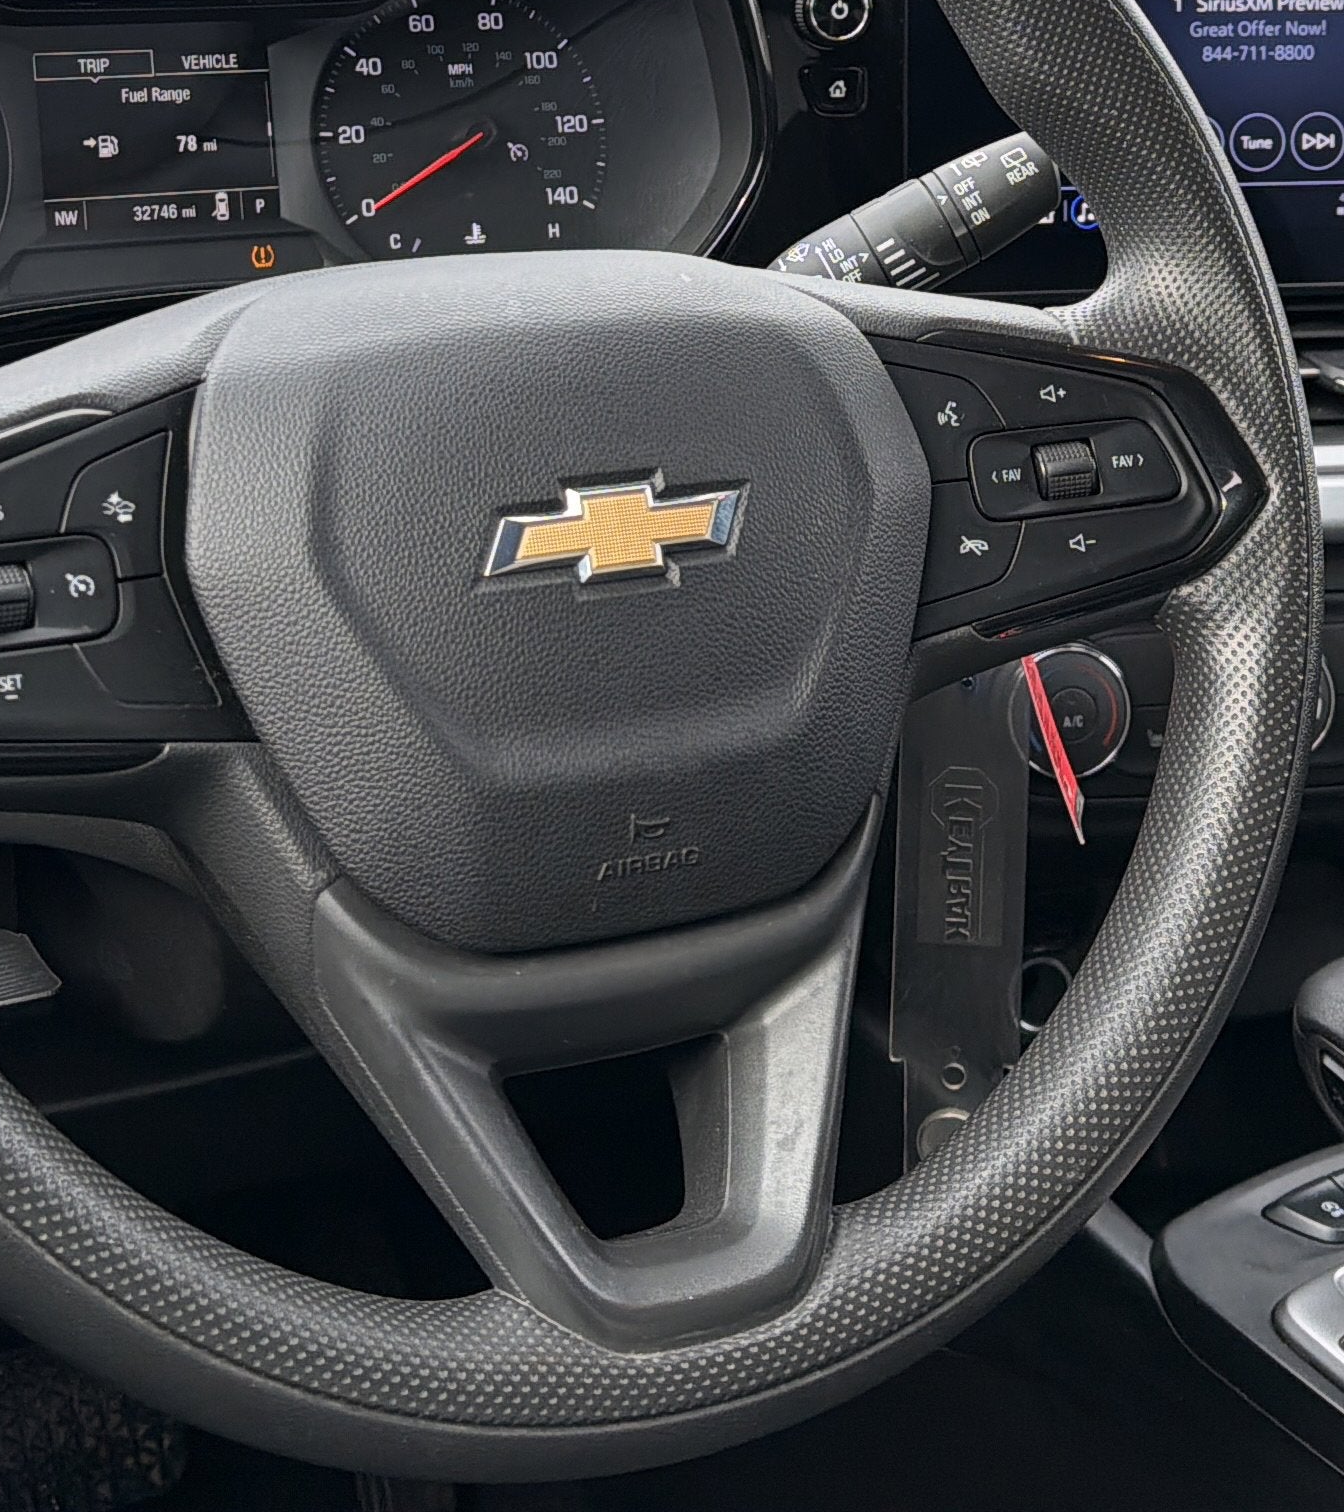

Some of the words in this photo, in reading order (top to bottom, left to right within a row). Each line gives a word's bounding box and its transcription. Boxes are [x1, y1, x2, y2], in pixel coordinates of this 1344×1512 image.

[408, 14, 435, 32] 60
[477, 13, 503, 30] 80
[1190, 22, 1234, 39] Great
[1238, 21, 1282, 38] Offer
[1285, 20, 1327, 37] Now!
[427, 44, 445, 55] 100
[462, 42, 479, 53] 120
[1202, 45, 1315, 62] 844-711-8800
[77, 58, 110, 74] TRIP
[181, 54, 239, 70] VEHICLE
[355, 58, 382, 76] 40
[524, 51, 558, 69] 100
[448, 63, 473, 76] MPH
[121, 87, 148, 103] Fuel
[152, 87, 191, 104] Range
[555, 115, 588, 133] 120
[338, 125, 365, 144] 20
[176, 135, 197, 152] 78
[203, 139, 217, 151] mi
[1240, 136, 1273, 151] Tune
[372, 153, 387, 163] 20
[1006, 161, 1040, 186] REAR
[953, 176, 976, 197] OFF
[545, 187, 578, 205] 140
[961, 191, 983, 212] INT
[132, 205, 178, 221] 32746
[181, 205, 197, 218] mi
[256, 199, 265, 213] P
[361, 199, 376, 217] 0
[55, 210, 78, 226] NW
[970, 206, 991, 226] ON
[548, 223, 560, 238] H
[390, 234, 402, 250] C
[821, 237, 837, 253] HI
[829, 248, 845, 264] LO
[839, 257, 860, 274] INT
[842, 268, 863, 284] OFF
[1112, 454, 1134, 468] FAV
[1002, 469, 1021, 482] FAV
[1063, 715, 1083, 728] A/C
[596, 847, 701, 882] AIRBAG
